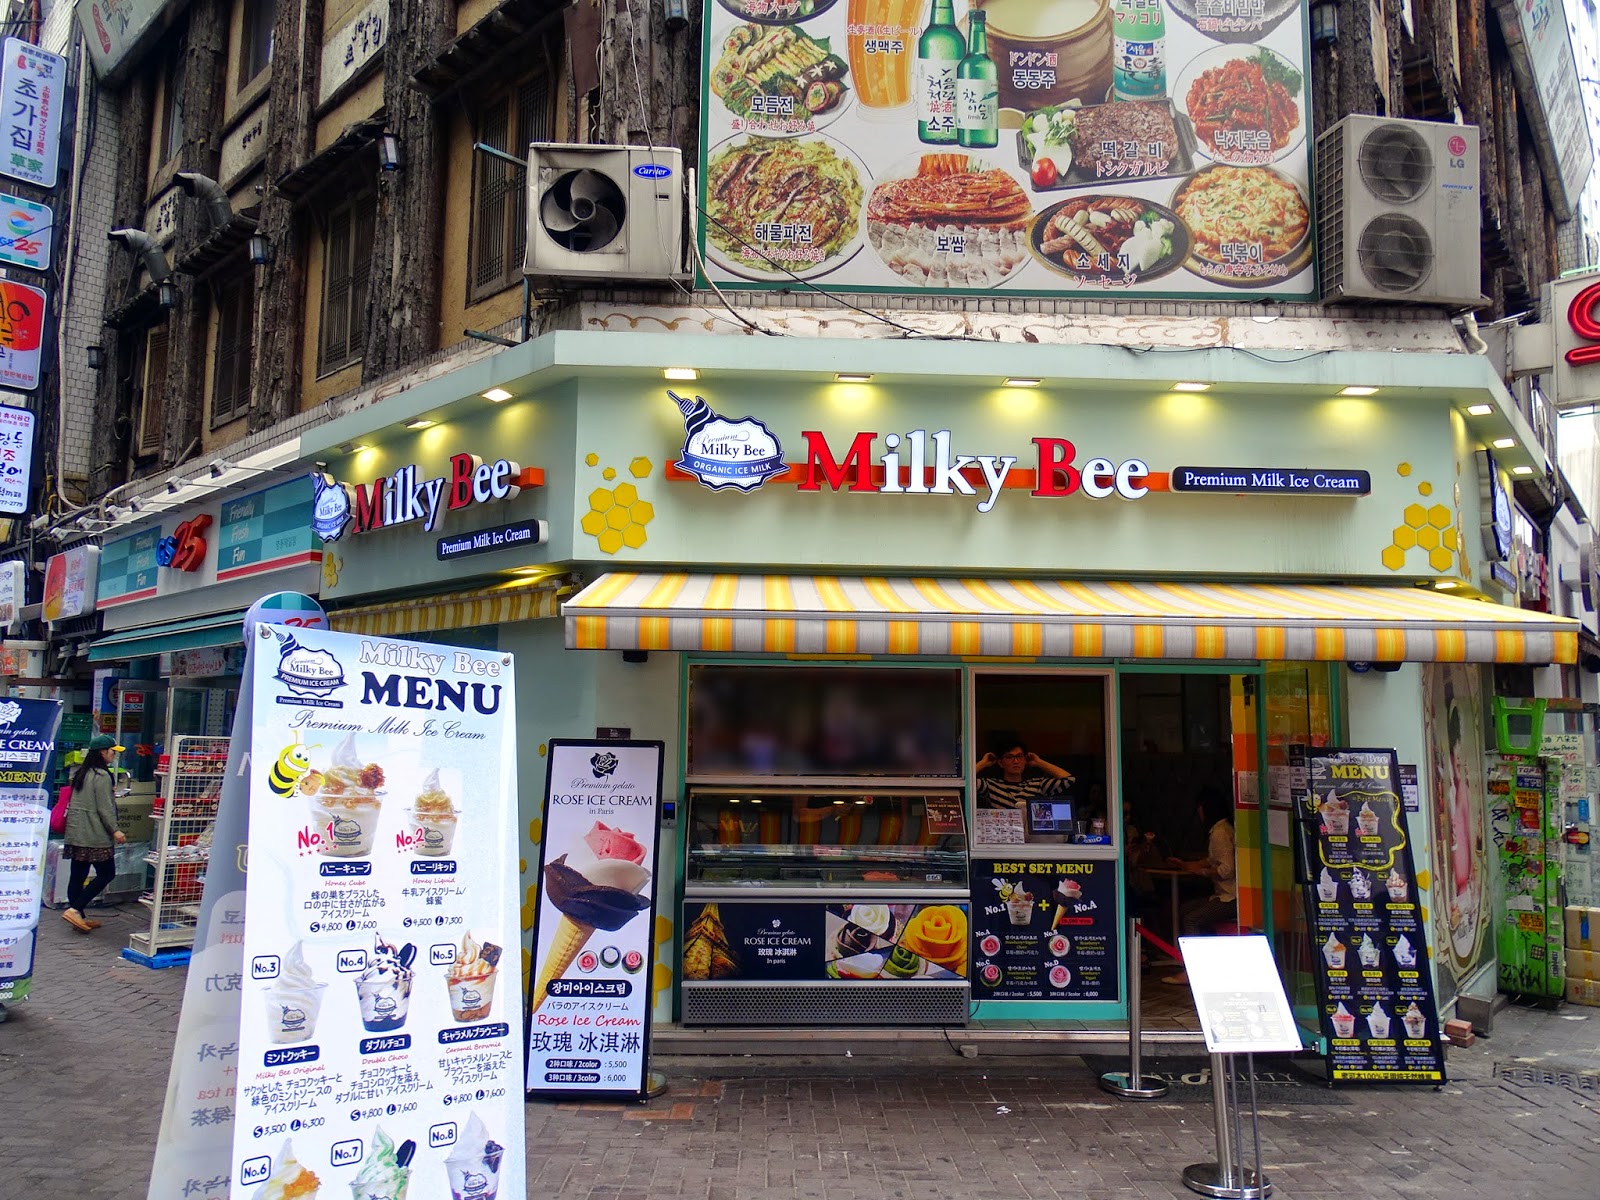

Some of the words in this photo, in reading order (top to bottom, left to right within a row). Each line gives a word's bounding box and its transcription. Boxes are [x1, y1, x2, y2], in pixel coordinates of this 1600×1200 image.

[1115, 12, 1161, 25] マッコリ
[865, 40, 903, 54] 생맥주
[1009, 51, 1058, 67] ドンドン酒
[927, 75, 955, 90] 처음
[1013, 69, 1056, 90] 동동주
[927, 89, 956, 101] 처럼
[751, 97, 793, 114] 모듬전
[10, 77, 39, 152] 초가집
[928, 116, 954, 132] 소주
[1215, 130, 1271, 150] 낙지볶음
[1449, 158, 1465, 169] LG
[638, 166, 668, 176] Carrier
[755, 223, 812, 242] 해물파전
[936, 236, 966, 252] 보쌈
[1220, 242, 1263, 263] 떡볶이
[1074, 273, 1138, 289] ソーセージ
[697, 431, 746, 444] Premium
[701, 443, 740, 458] Milky
[744, 444, 765, 457] Bee
[693, 460, 732, 475] ORGANIC
[734, 466, 748, 474] ICE
[750, 461, 772, 474] MILK
[798, 430, 1017, 513] Milky
[1031, 437, 1150, 499] Bee
[1184, 471, 1247, 487] Premium
[1251, 473, 1285, 488] Milk
[1288, 474, 1309, 488] Ice
[1313, 475, 1359, 490] Cream
[352, 464, 446, 533] Milky
[449, 452, 511, 510] Bee
[229, 504, 255, 523] Friendly
[231, 525, 249, 543] Fresh
[156, 513, 213, 572] GS25
[441, 539, 472, 555] Premium
[474, 531, 490, 548] Milk
[493, 531, 503, 545] Ice
[505, 528, 531, 542] Cream
[232, 547, 246, 565] Fun
[360, 641, 446, 674] Milky
[452, 652, 501, 677] Bee
[290, 664, 317, 676] Milky
[319, 667, 334, 676] Bee
[281, 674, 309, 686] PREMIUM
[360, 671, 502, 715] MENU
[279, 697, 302, 705] Premium
[288, 709, 364, 732] Premium
[368, 716, 409, 736] Milk
[413, 719, 439, 737] Ice
[444, 721, 486, 741] Cream
[9, 740, 54, 750] CREAM
[1366, 754, 1388, 764] Bee
[0, 772, 46, 783] MENU
[1331, 765, 1390, 779] MENU
[571, 778, 611, 789] Premium
[612, 782, 635, 795] gelato
[552, 794, 584, 806] ROSE
[587, 795, 606, 806] ICE
[609, 795, 652, 806] CREAM
[396, 828, 424, 848] No.2
[320, 863, 371, 875] ハニーキューブ
[412, 862, 455, 873] ハニーリキッド
[993, 863, 1025, 874] BEST
[1029, 863, 1053, 874] SET
[1056, 863, 1094, 875] MENU
[325, 879, 347, 889] Honey
[413, 877, 432, 886] Honey
[434, 877, 456, 886] Liquid
[311, 889, 380, 900] 蜂の巣をプラスした
[426, 896, 442, 905] 蜂蜜
[304, 899, 385, 909] 口の中に甘さが広がる
[985, 903, 1006, 915] No.1
[1074, 900, 1097, 913] No.A
[321, 908, 369, 919] アイスクリーム
[976, 929, 990, 937] No.A
[1043, 929, 1058, 938] No.B
[744, 937, 766, 945] ROSE
[767, 937, 780, 945] ICE
[782, 937, 812, 945] CREAM
[432, 949, 453, 960] No.5
[758, 948, 773, 956] 玫瑰
[775, 948, 797, 956] 冰淇淋
[255, 962, 276, 973] No.3
[340, 955, 364, 967] No.4
[976, 959, 990, 968] No.C
[1044, 960, 1059, 968] No.D
[552, 982, 626, 995] 장미아이스크림
[547, 1001, 629, 1011] バラのアイスクリーム
[537, 1014, 569, 1027] Rose
[573, 1014, 591, 1026] Ice
[595, 1014, 641, 1027] Cream
[442, 1026, 505, 1041] キャラメルブラウニー
[365, 1037, 405, 1052] ダブルチョコ
[446, 1045, 473, 1054] Caramel
[474, 1042, 501, 1050] Brownie
[532, 1031, 572, 1052] 玫瑰
[578, 1031, 641, 1054] 冰淇淋
[267, 1049, 316, 1064] ミントクッキー
[362, 1057, 386, 1065] Double
[388, 1054, 408, 1062] Choco
[438, 1050, 512, 1069] 甘いキャラメルソースと
[444, 1060, 506, 1077] ブラウニーを添えた
[578, 1060, 598, 1068] 2color
[256, 1071, 276, 1080] Milky
[278, 1069, 291, 1077] Bee
[293, 1064, 325, 1075] Original
[360, 1064, 411, 1079] チョコクッキーと
[452, 1071, 497, 1086] アイスクリーム
[577, 1074, 598, 1082] 3color
[244, 1081, 283, 1097] サクッとした
[286, 1073, 343, 1090] チョコクッキーと
[351, 1072, 420, 1091] チョコシロップを添え
[386, 1080, 433, 1097] アイスクリーム
[486, 1088, 505, 1099] 7,600
[264, 1098, 317, 1115] アイスクリーム
[397, 1102, 417, 1114] 7,600
[432, 1130, 454, 1143] No.8
[334, 1146, 359, 1160] No.7
[244, 1163, 268, 1178] No.6
